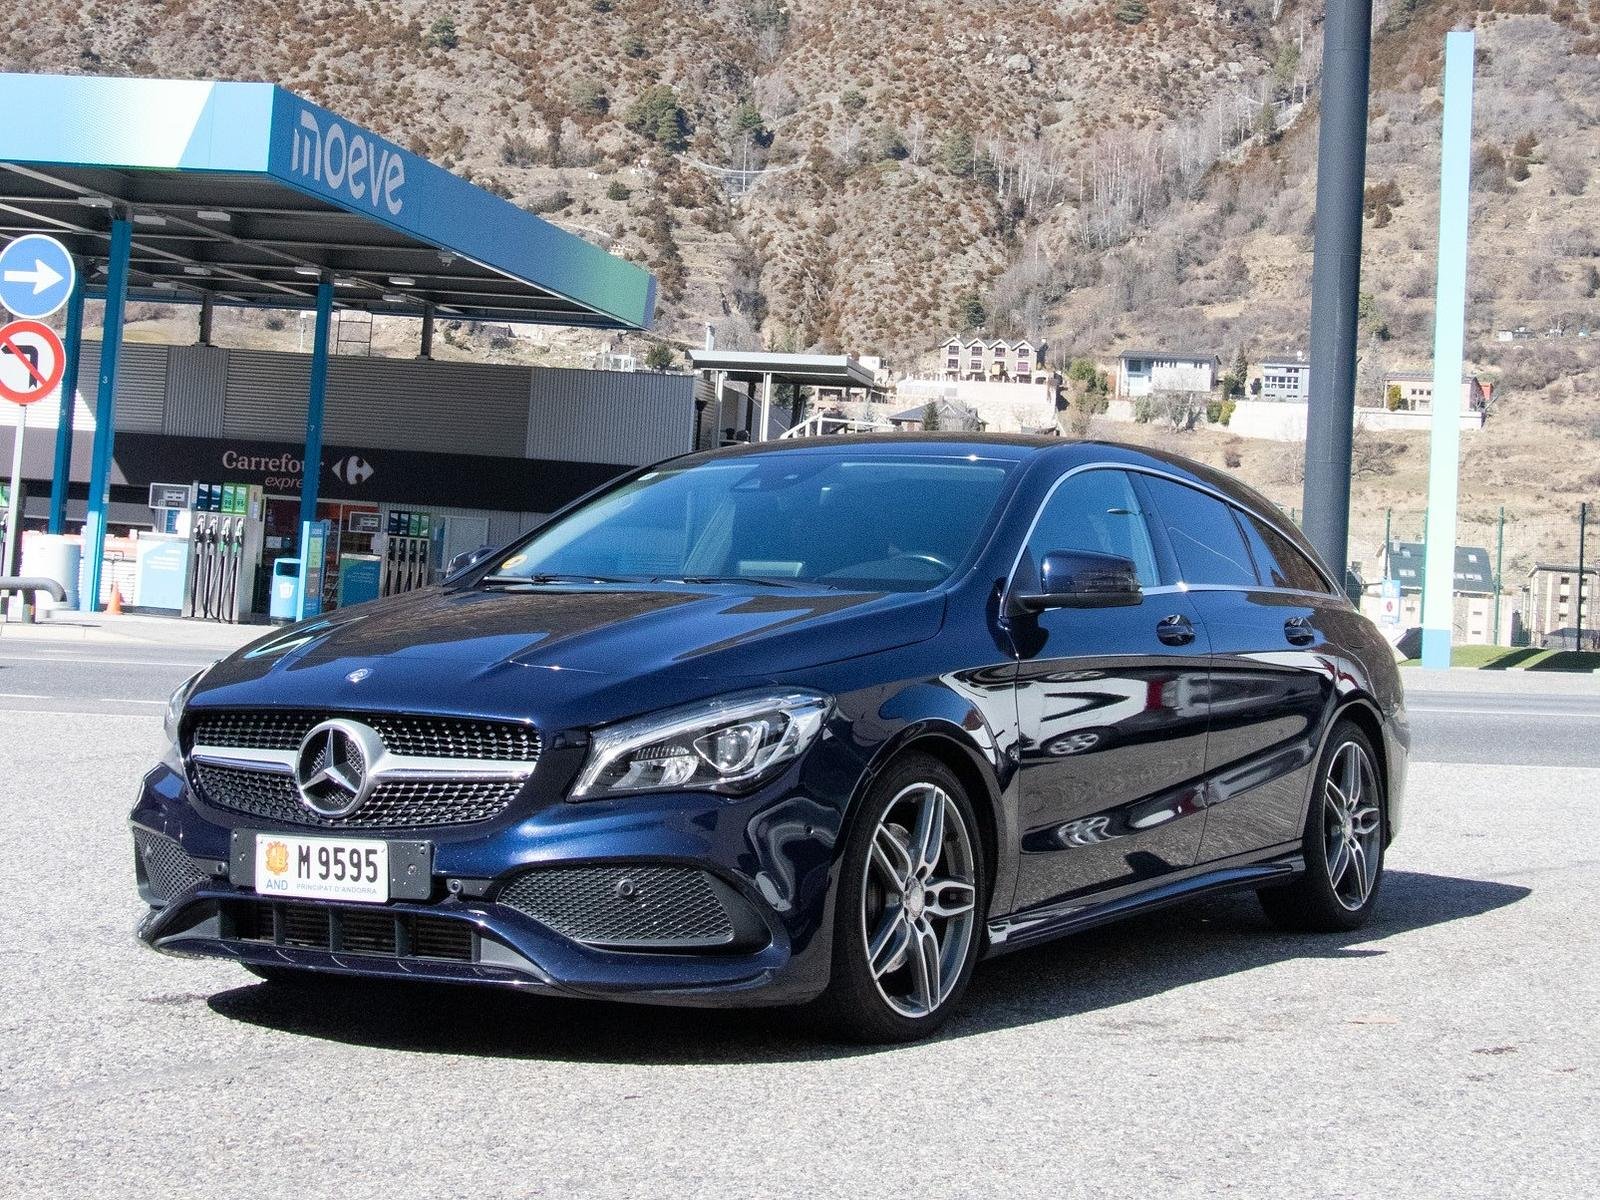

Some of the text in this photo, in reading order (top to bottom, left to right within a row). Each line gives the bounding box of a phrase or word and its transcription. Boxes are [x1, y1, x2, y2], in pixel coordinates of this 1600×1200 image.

[291, 109, 405, 215] moeve
[102, 375, 108, 384] 3
[222, 450, 324, 473] Carrefo
[265, 474, 303, 490] expre
[297, 845, 378, 883] M 9595
[266, 879, 288, 891] AND
[297, 883, 377, 894] PRINCIPAT D'ANDORRA
